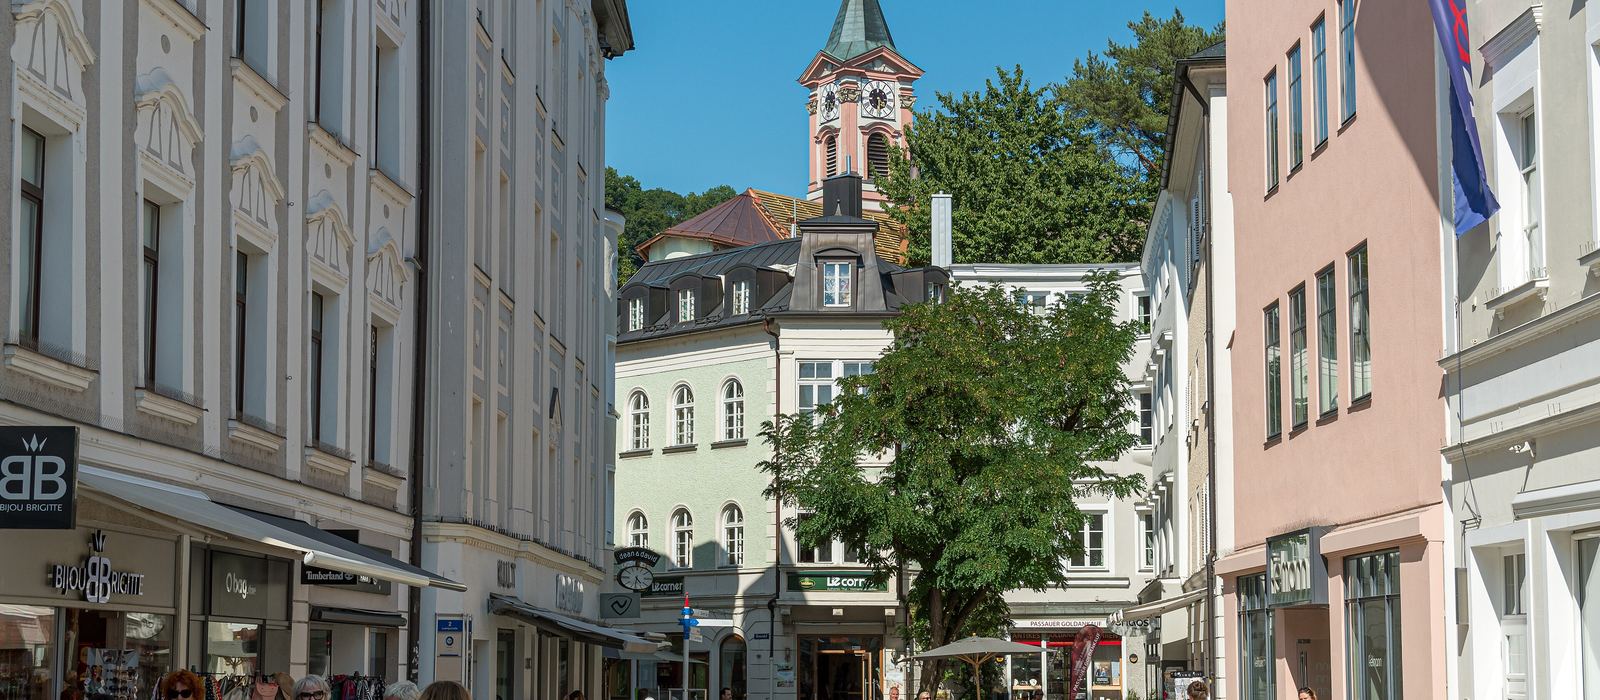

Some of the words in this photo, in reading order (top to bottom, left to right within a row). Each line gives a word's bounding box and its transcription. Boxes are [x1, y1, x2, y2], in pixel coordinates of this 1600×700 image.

[0, 503, 23, 512] BIJOU
[26, 503, 63, 512] BRIGITTE
[619, 551, 635, 560] dean
[640, 551, 658, 562] david
[55, 564, 87, 596] BIJOU
[306, 570, 344, 580] Timberland
